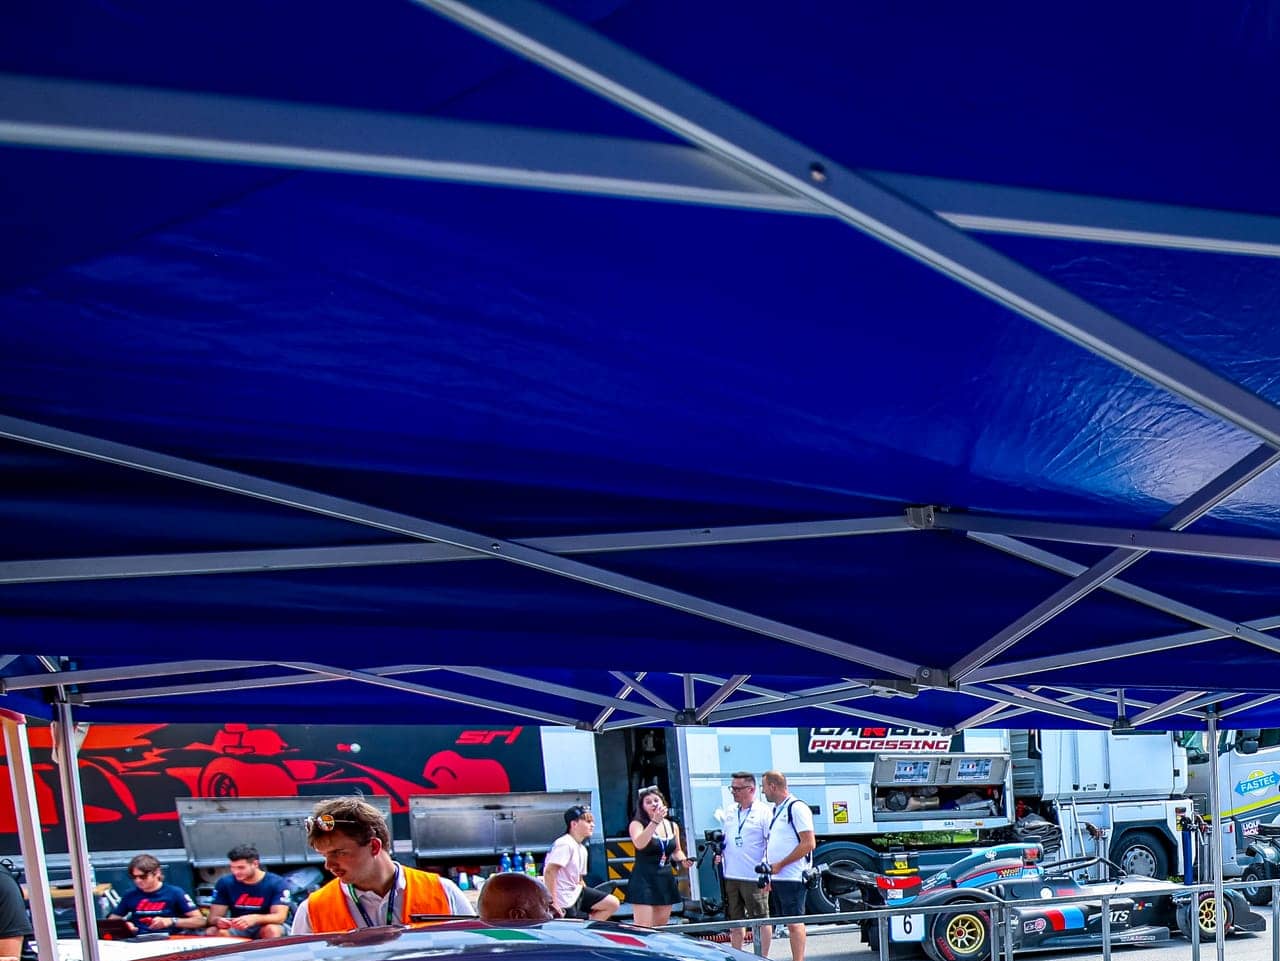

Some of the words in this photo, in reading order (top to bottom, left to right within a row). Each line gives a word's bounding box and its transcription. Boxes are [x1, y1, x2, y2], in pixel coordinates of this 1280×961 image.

[810, 739, 950, 751] PROCESSING
[1240, 774, 1276, 793] FASTEC
[903, 913, 913, 935] 6
